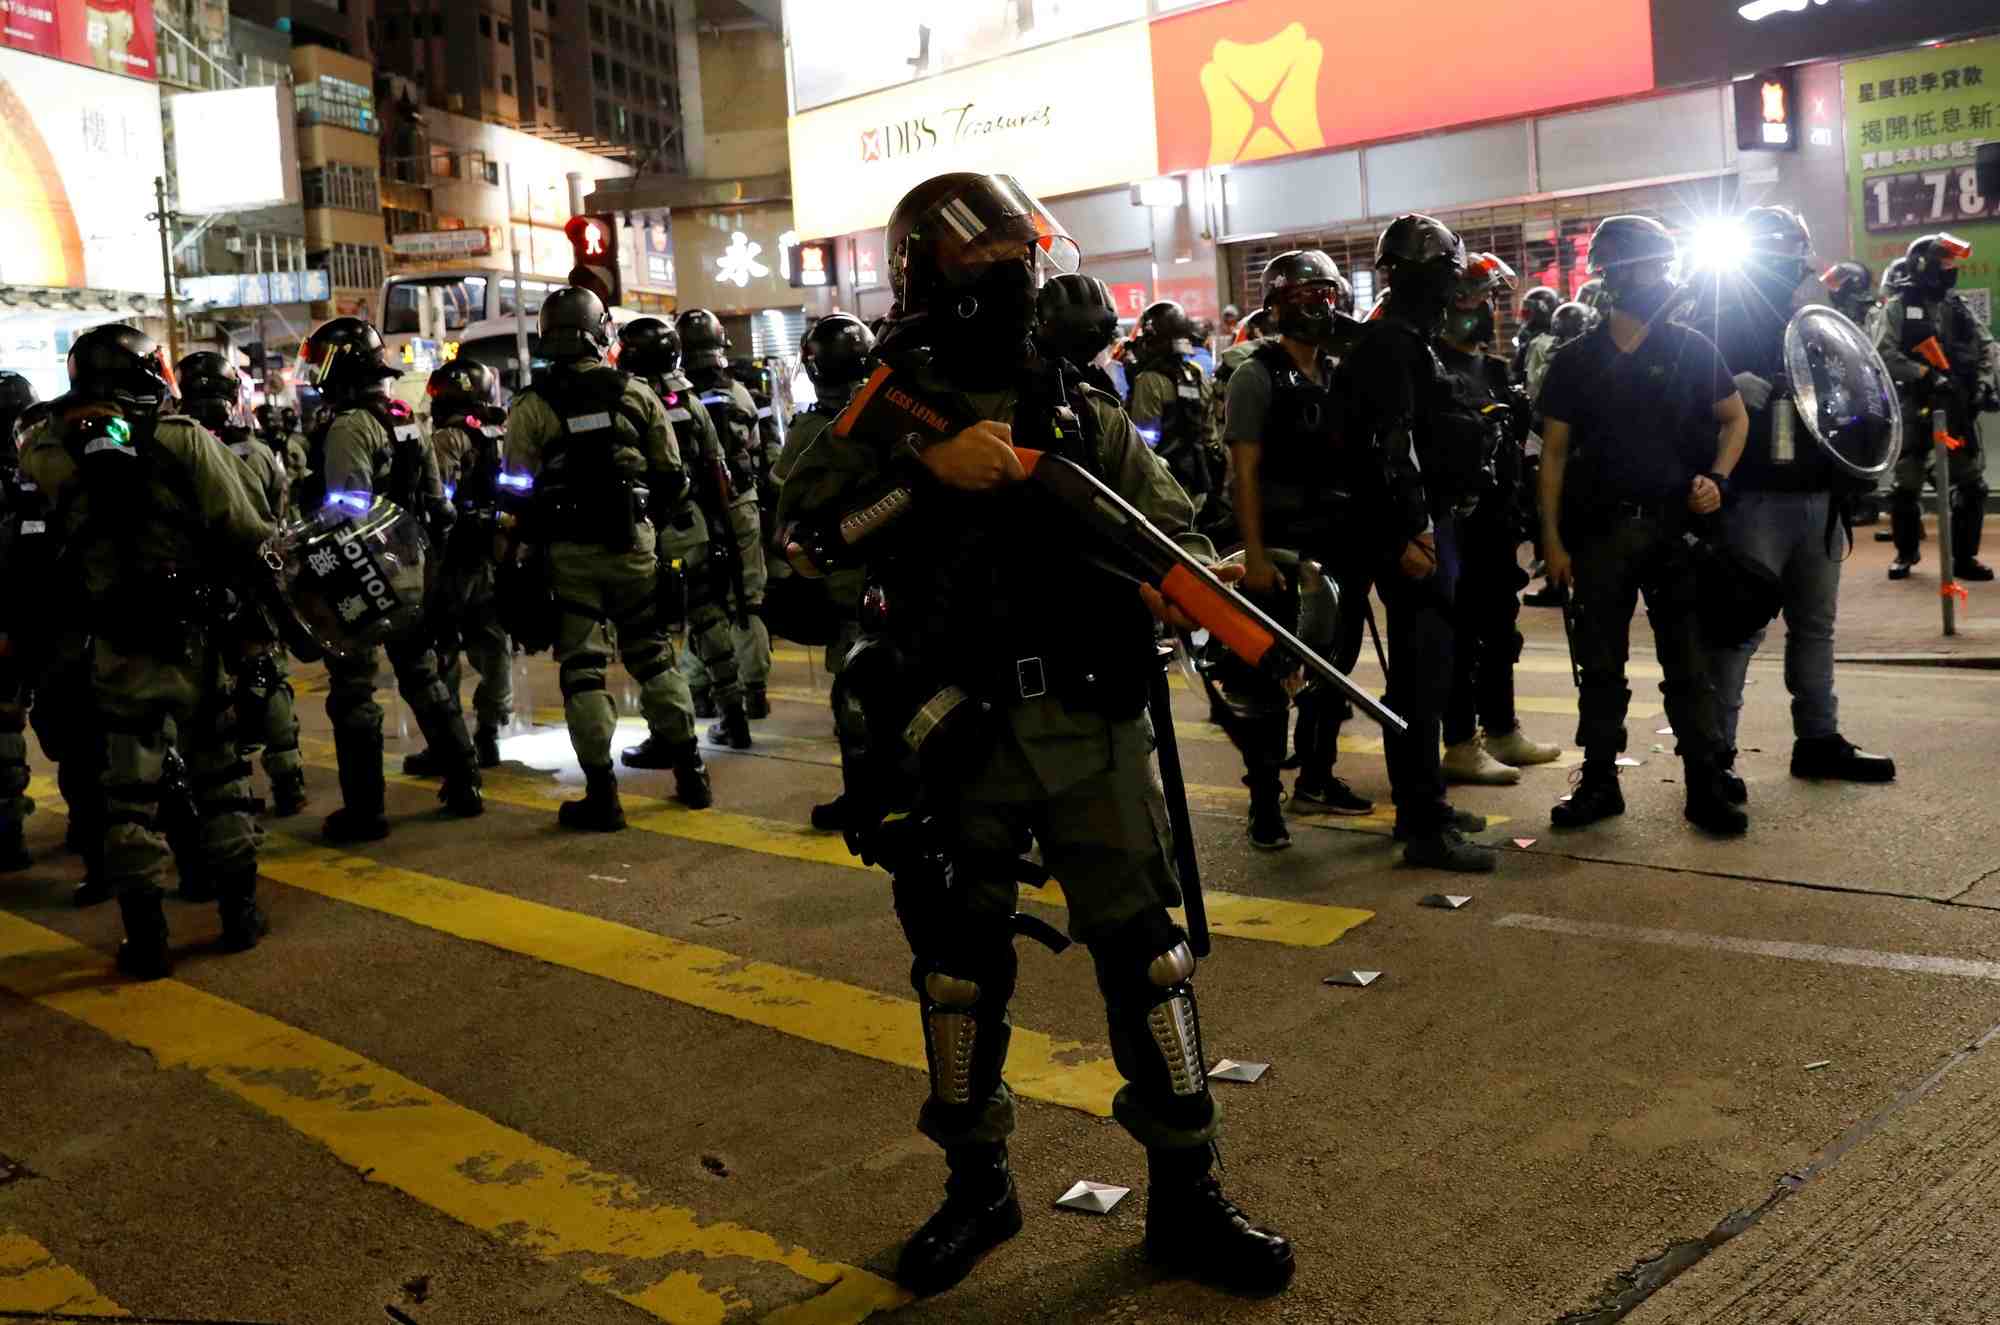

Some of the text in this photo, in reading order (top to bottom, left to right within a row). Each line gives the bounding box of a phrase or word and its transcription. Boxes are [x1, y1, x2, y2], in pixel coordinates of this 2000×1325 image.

[884, 115, 937, 158] DBS
[1860, 101, 2000, 146] 揭開低息新
[884, 387, 912, 410] LESS
[333, 526, 396, 611] POLICE
